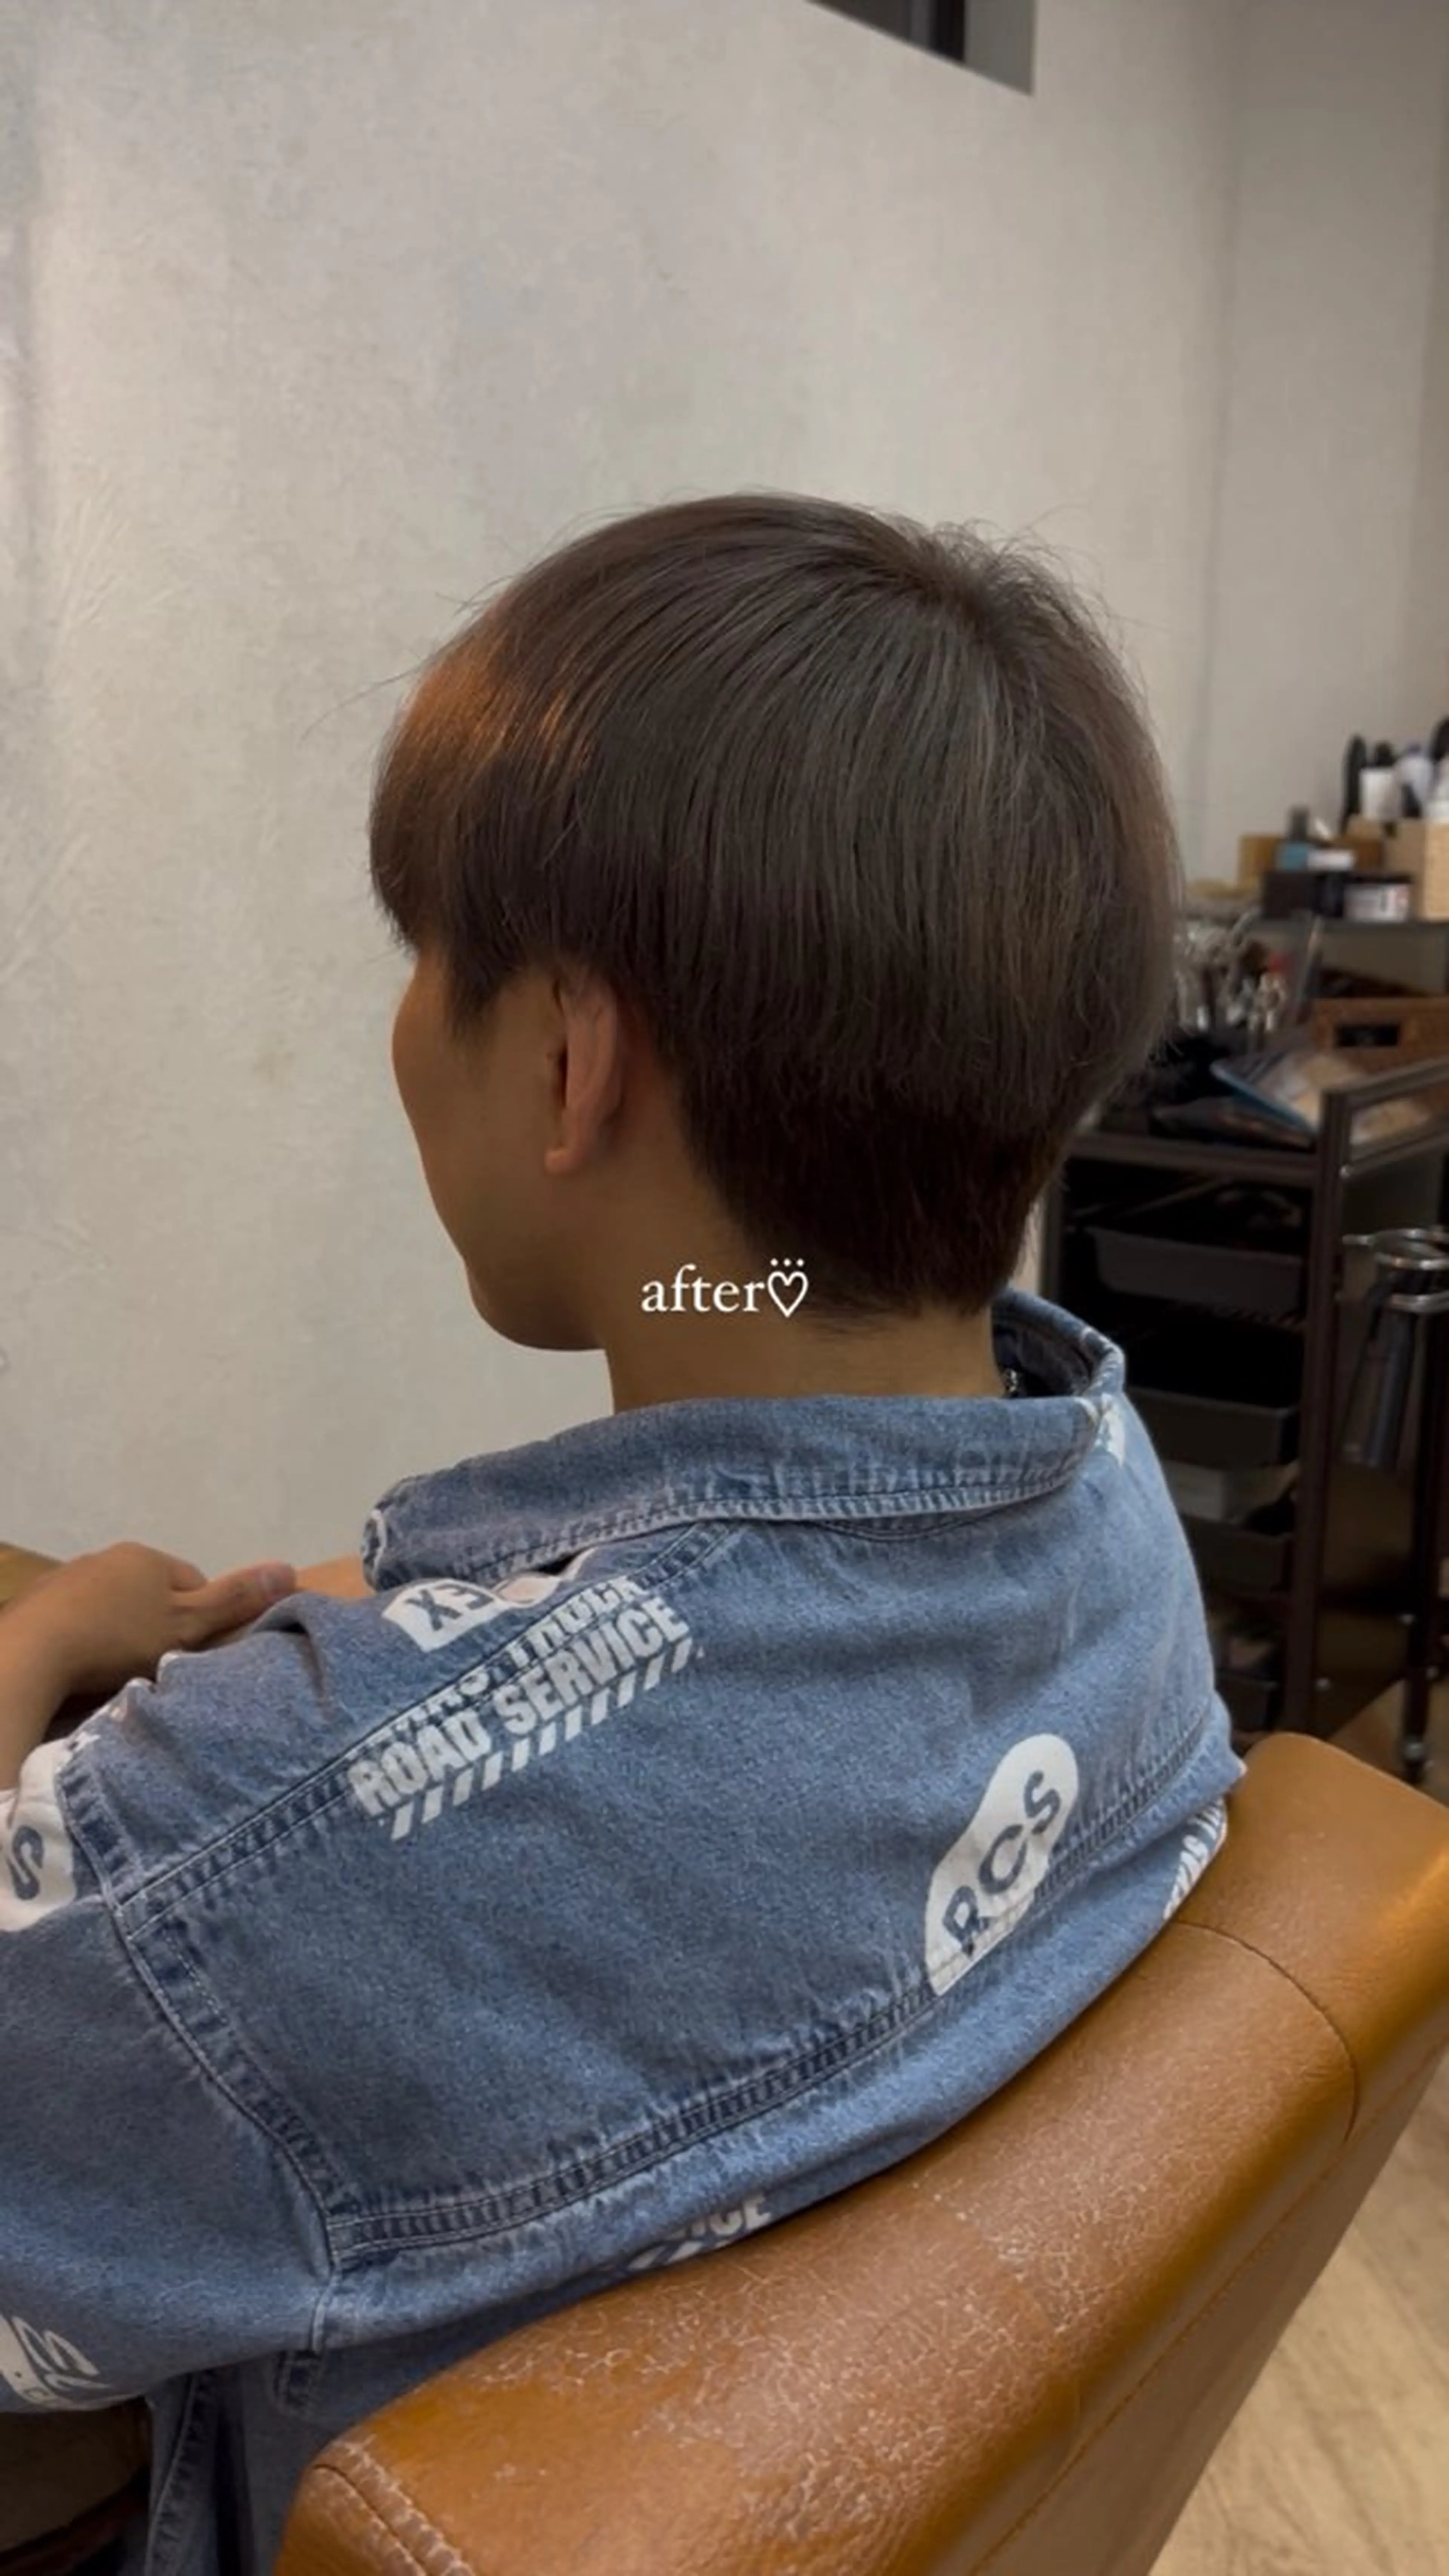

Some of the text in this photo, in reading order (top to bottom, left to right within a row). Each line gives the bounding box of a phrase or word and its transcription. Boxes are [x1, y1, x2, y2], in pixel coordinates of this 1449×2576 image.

[346, 1707, 491, 1816] ROAD
[494, 1597, 690, 1735] SERVICE
[942, 1770, 1062, 1958] RCS
